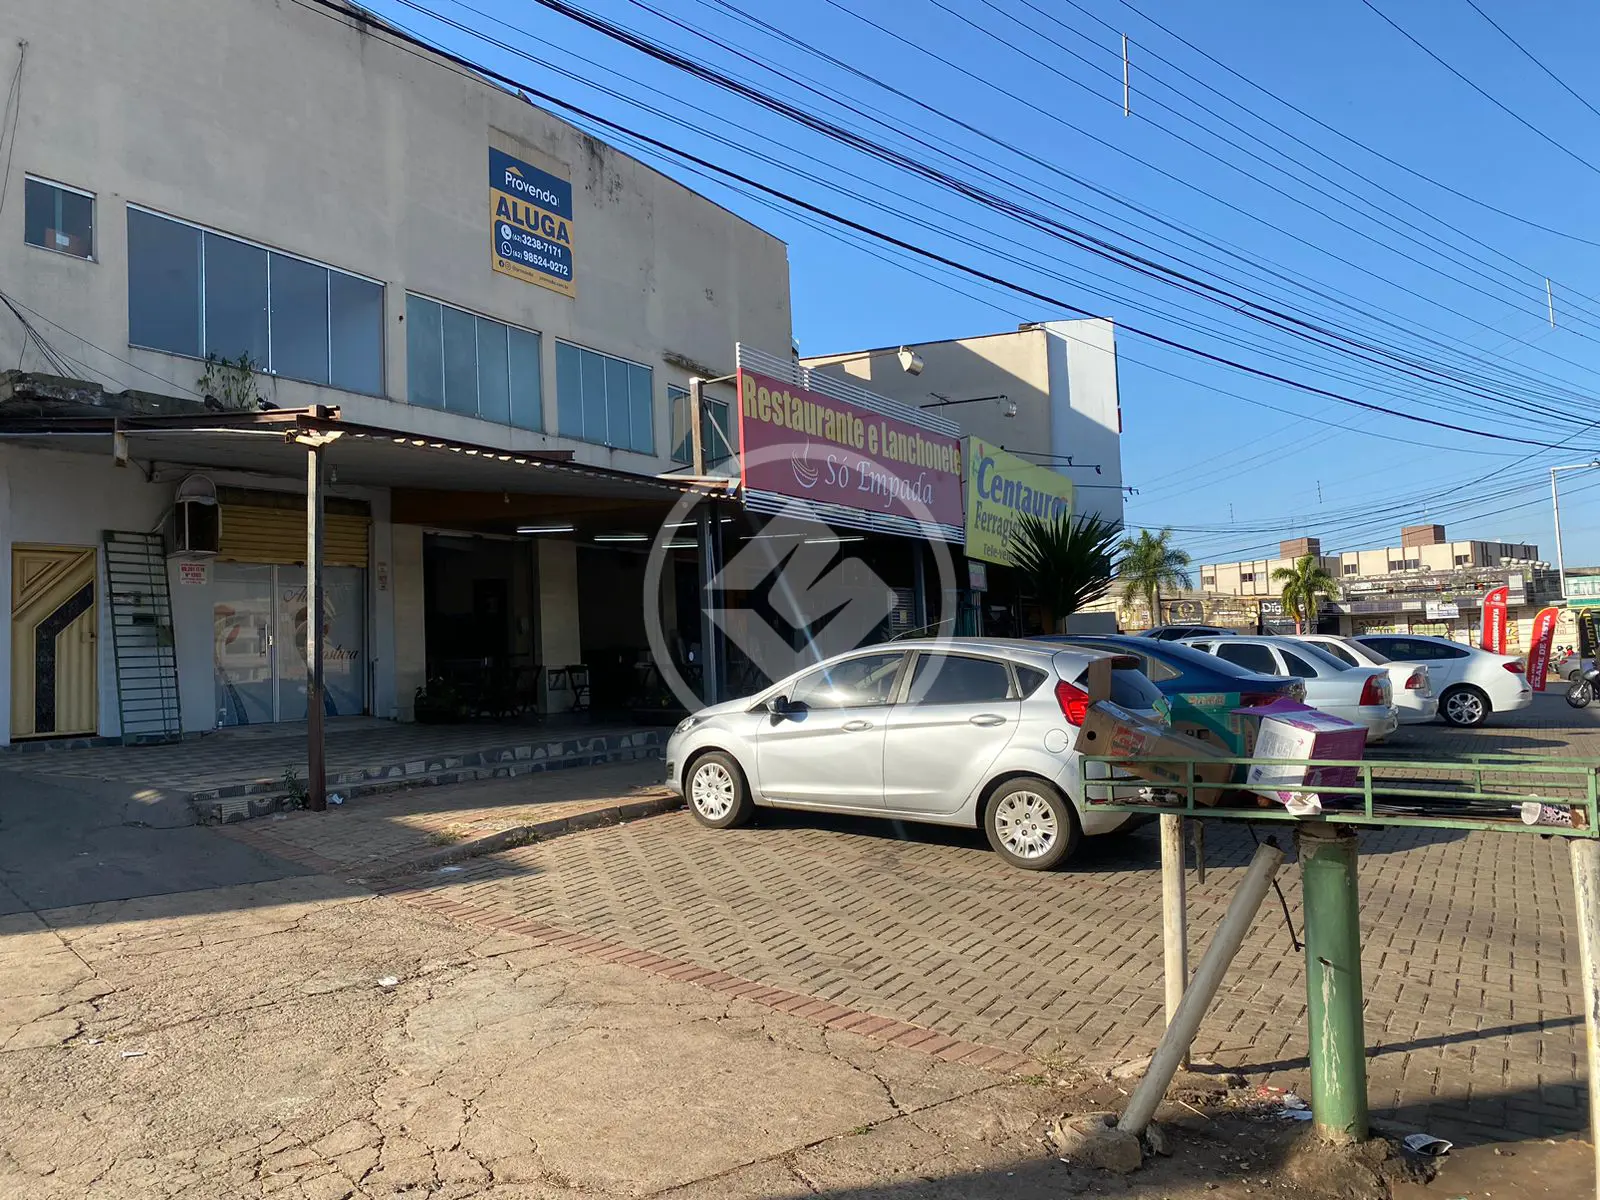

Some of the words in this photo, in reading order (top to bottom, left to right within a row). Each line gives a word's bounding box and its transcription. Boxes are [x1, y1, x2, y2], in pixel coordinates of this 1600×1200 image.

[505, 171, 558, 206] Provenda
[496, 196, 570, 244] ALUGA
[522, 234, 561, 257] 3238-7171
[523, 250, 568, 275] 98524-0272
[741, 375, 865, 450] Restaurante
[867, 423, 878, 456] e
[882, 421, 961, 476] Lanchonete
[825, 454, 849, 489] Só
[856, 460, 933, 508] Empada
[977, 456, 1065, 521] Centauro
[1541, 614, 1551, 642] VISTA
[1539, 642, 1546, 657] DE
[1534, 656, 1543, 688] EXAME
